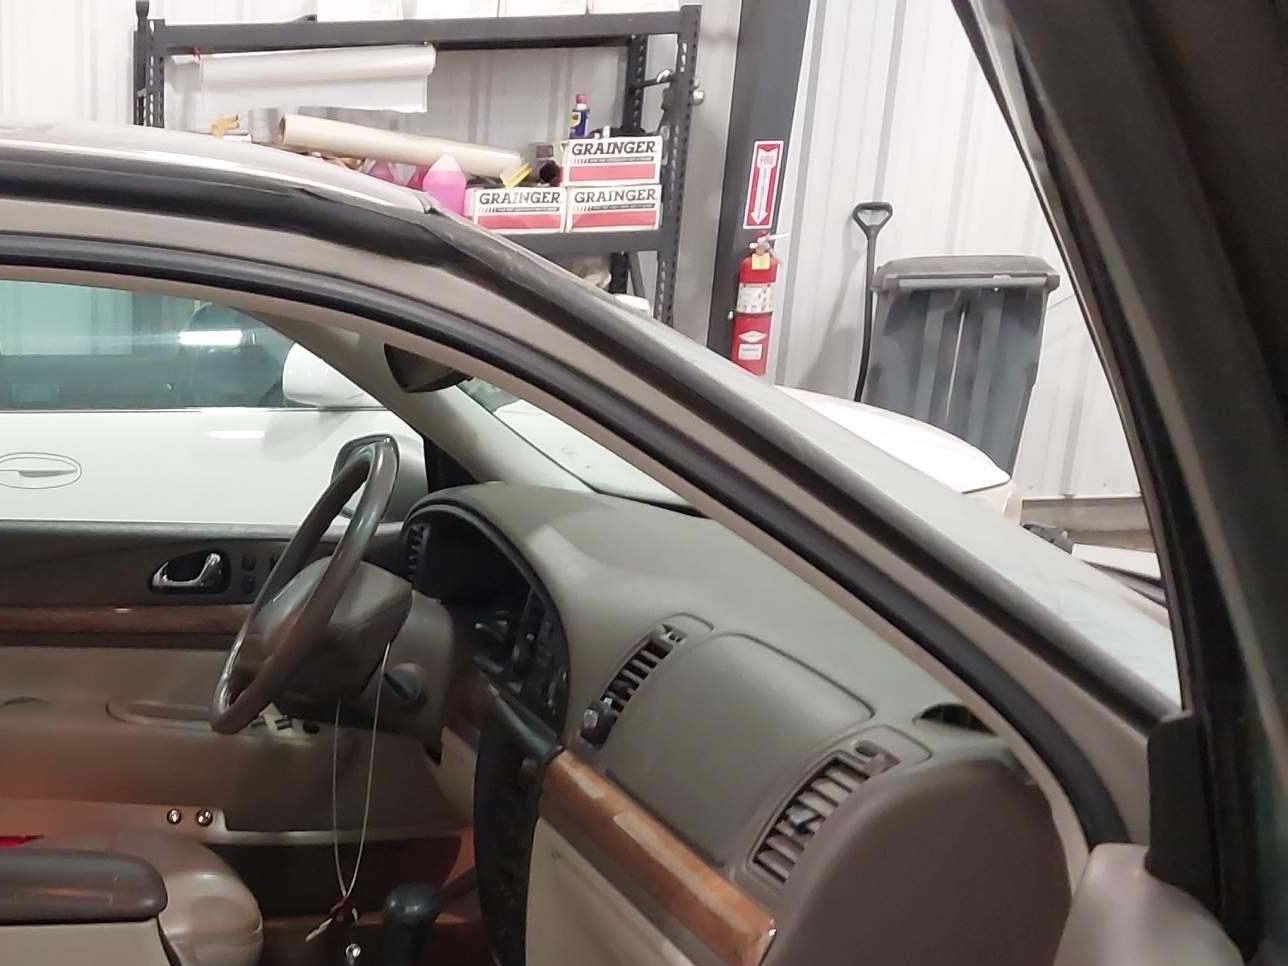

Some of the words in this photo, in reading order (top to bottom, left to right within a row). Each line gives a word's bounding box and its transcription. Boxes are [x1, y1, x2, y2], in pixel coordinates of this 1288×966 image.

[571, 141, 656, 156] GRAINGER
[479, 191, 561, 205] GRAINGER
[574, 188, 656, 204] GRAINGER
